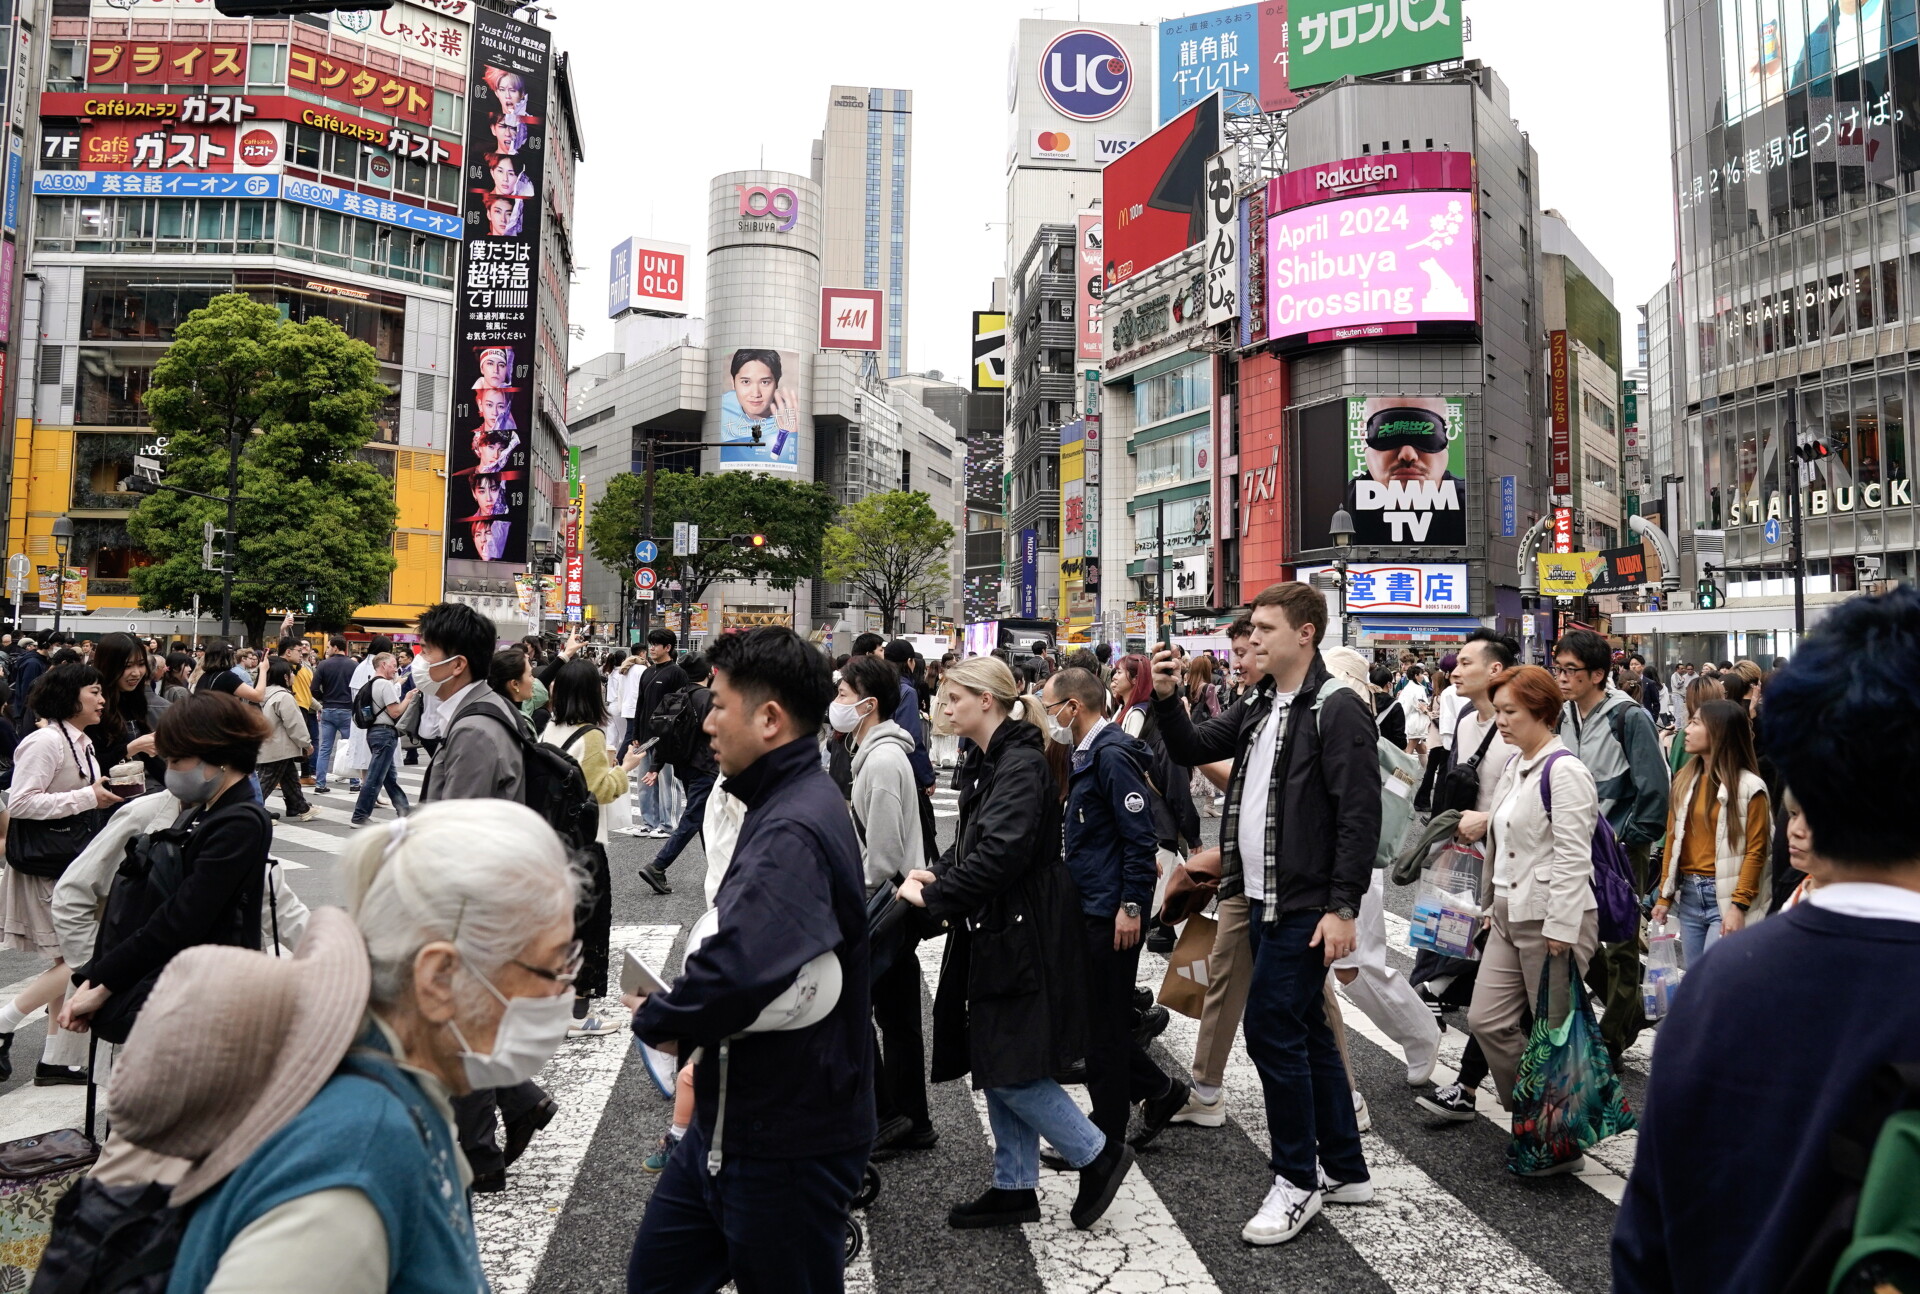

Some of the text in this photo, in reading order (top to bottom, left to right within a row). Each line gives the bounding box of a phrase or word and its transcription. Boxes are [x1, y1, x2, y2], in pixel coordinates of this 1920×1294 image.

[380, 10, 462, 56] しゃぶ葉
[478, 23, 503, 37] Just
[1165, 12, 1252, 36] のど、直接、うるおう
[1299, 0, 1450, 55] サロンパス
[92, 45, 243, 75] プライス
[481, 36, 543, 64] 2024.04.17 ON SALE
[1180, 31, 1239, 67] 龍角散
[289, 51, 429, 113] コンタクト
[1172, 58, 1250, 95] ダイレクト
[474, 84, 487, 99] 02
[181, 96, 255, 123] ガスト
[834, 100, 864, 108] INDIGO
[44, 137, 80, 158] 7F
[89, 136, 129, 152] Café
[132, 132, 226, 169] ガスト
[243, 145, 274, 157] ガスト
[388, 129, 449, 164] ガスト
[528, 136, 541, 150] 03
[88, 153, 127, 164] レストラン
[373, 164, 389, 173] ガスト
[40, 174, 88, 190] AEON
[470, 165, 483, 179] 04
[1315, 161, 1398, 191] Rakuten
[102, 175, 238, 193] 英会話イーオン
[248, 178, 268, 193] 6F
[290, 182, 334, 205] AEON
[343, 193, 460, 233] 英会話イーオン
[467, 210, 480, 224] 05
[735, 184, 799, 232] 109
[1129, 203, 1144, 221] 100m
[738, 220, 776, 232] SHIBUYA
[1208, 157, 1236, 315] もんじゃ
[1277, 205, 1410, 252] April 2024
[469, 240, 531, 261] 僕たちは
[467, 261, 530, 288] 超特急
[615, 250, 627, 279] THE
[643, 255, 676, 275] UNI
[1248, 195, 1263, 334] 三千里薬品
[1277, 248, 1396, 289] Shibuya
[643, 275, 679, 296] QLO
[1277, 281, 1414, 325] Crossing
[485, 322, 508, 331] 強風に
[836, 308, 868, 330] H&M
[466, 332, 526, 340] お気をつけください
[1336, 326, 1383, 338] Rakuten Vision
[516, 364, 529, 378] 07
[1553, 334, 1566, 424] クスリのことなら
[457, 404, 469, 418] 11
[1445, 403, 1463, 441] 再び
[723, 413, 751, 439] 大谷
[1379, 420, 1435, 435] 大脱出2
[1348, 401, 1369, 477] 脱出せよ
[513, 453, 525, 466] 12
[1554, 430, 1569, 487] 三千里
[511, 492, 523, 506] 13
[1355, 480, 1460, 510] DMM
[568, 527, 576, 548] アコム
[1383, 511, 1433, 542] TV
[568, 556, 582, 605] スギ薬局
